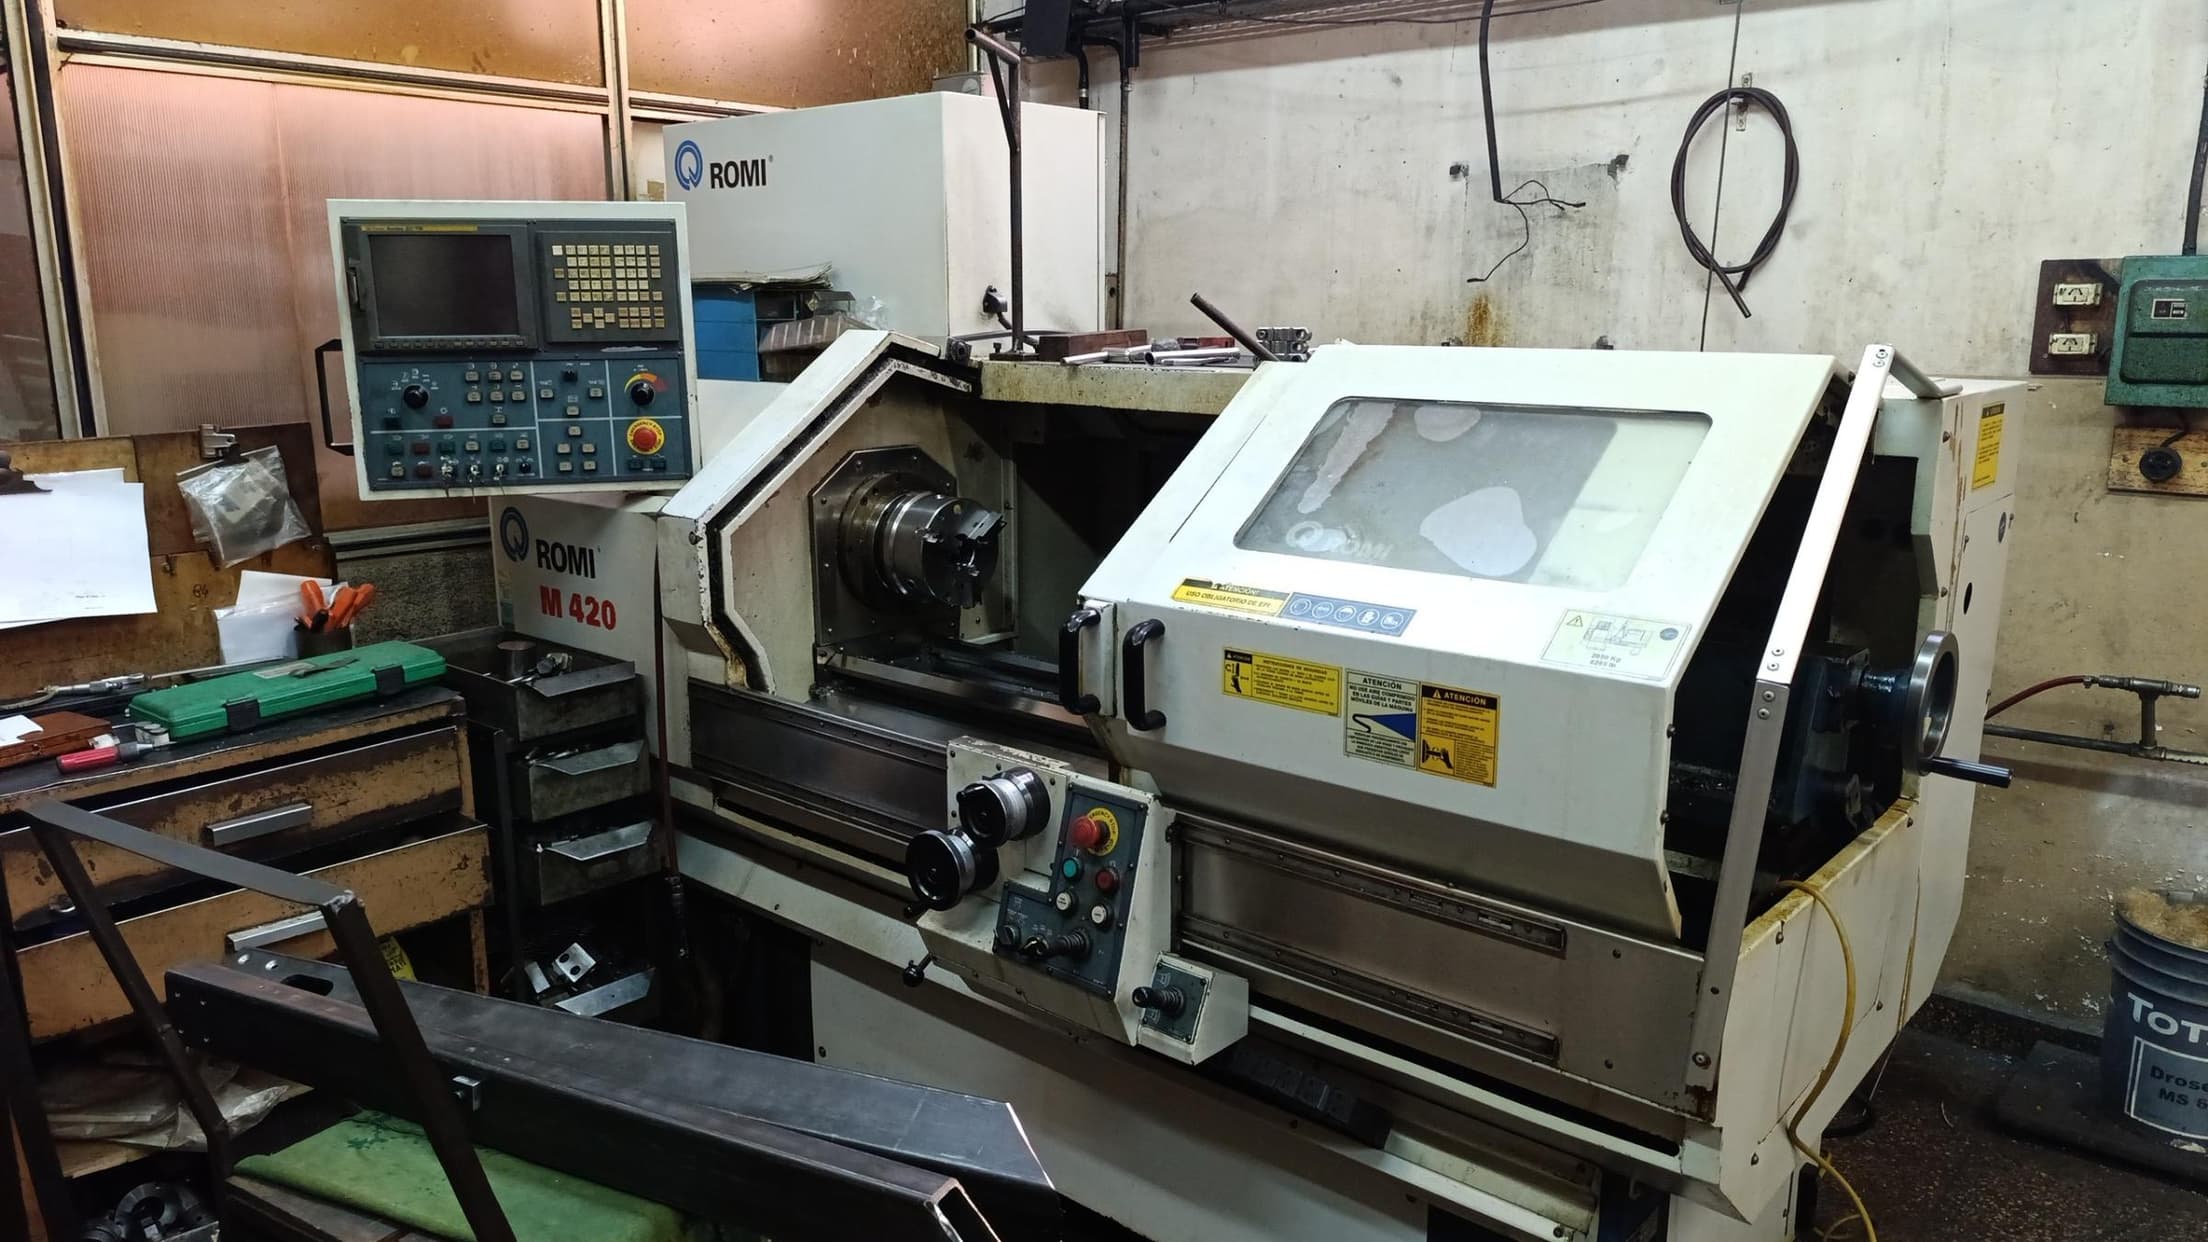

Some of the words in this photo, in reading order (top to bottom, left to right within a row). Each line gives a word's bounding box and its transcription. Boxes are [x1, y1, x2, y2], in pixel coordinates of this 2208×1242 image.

[709, 159, 767, 189] ROMI
[535, 539, 596, 579] ROMI
[539, 585, 563, 618] M
[569, 592, 616, 630] 420
[1201, 592, 1247, 604] OBLIGATORIO
[1362, 677, 1402, 690] ATENCIÓN
[1392, 698, 1412, 706] PARTES
[2127, 991, 2208, 1046] TOT
[2159, 1087, 2189, 1106] MS
